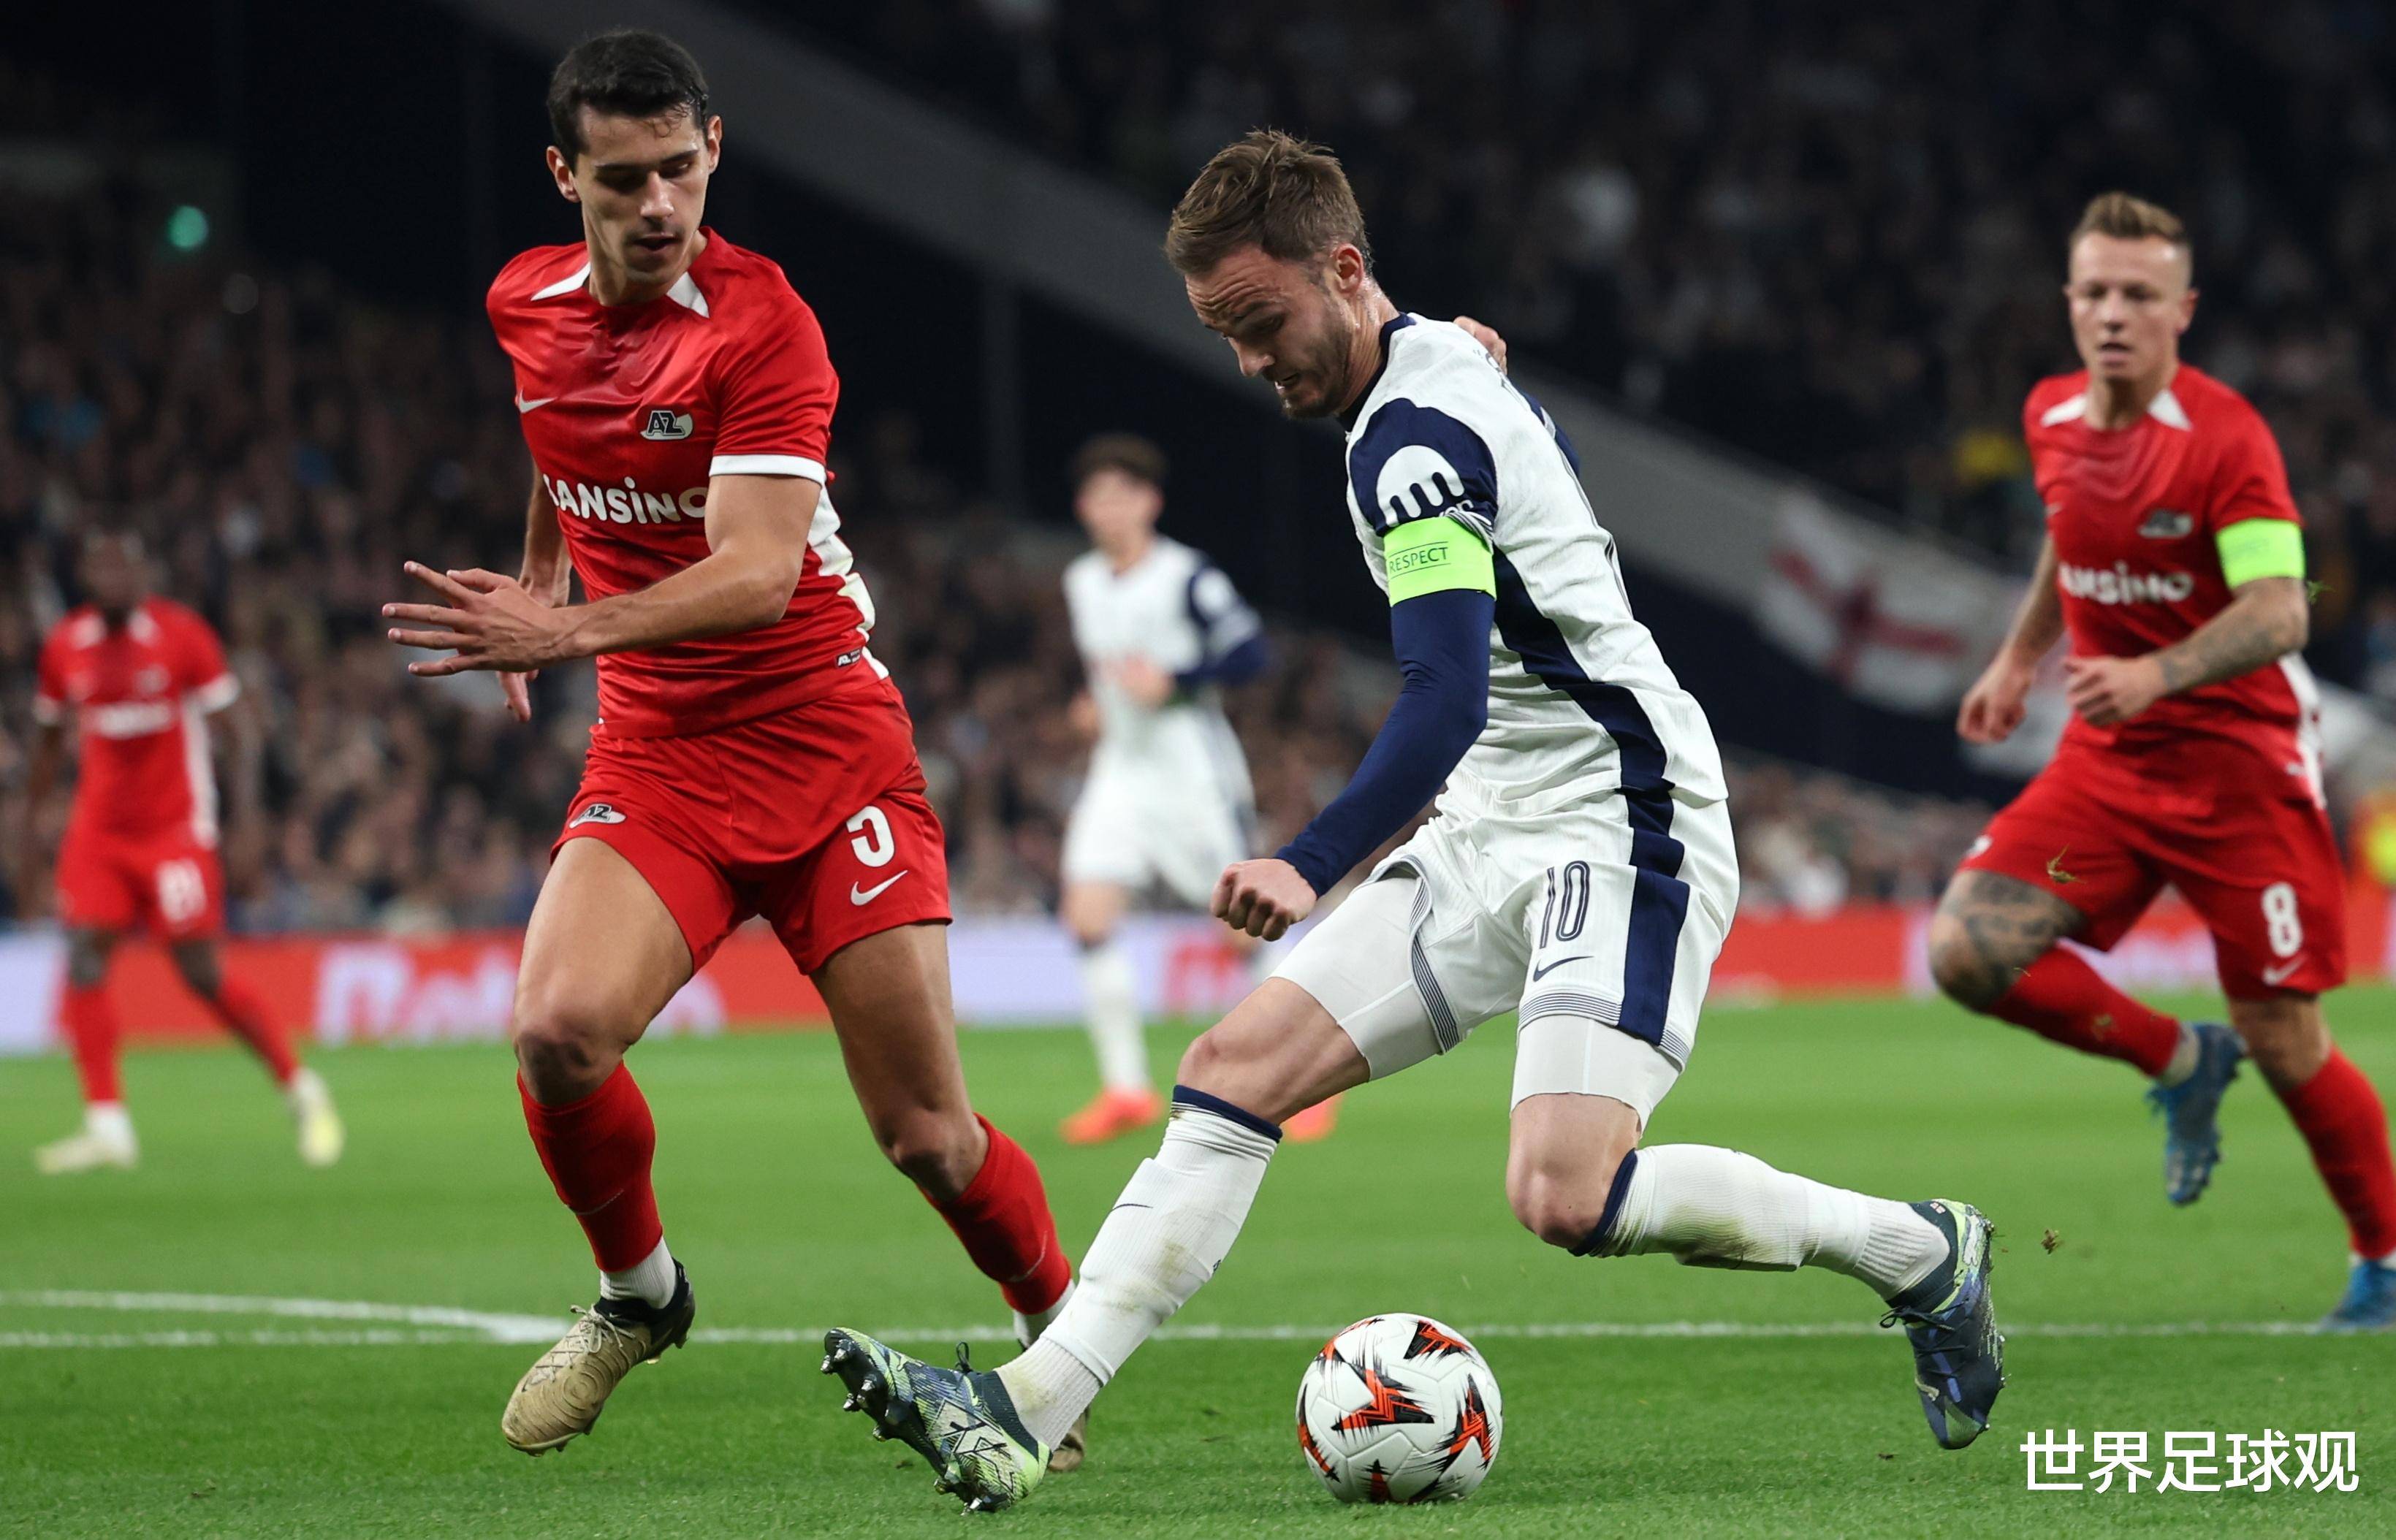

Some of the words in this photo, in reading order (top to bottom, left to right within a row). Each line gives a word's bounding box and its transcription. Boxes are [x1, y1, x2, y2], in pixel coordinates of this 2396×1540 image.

[647, 411, 685, 436] AZ
[1389, 546, 1449, 574] RESPECT
[1539, 860, 1591, 950] 10
[2261, 881, 2303, 958] 8
